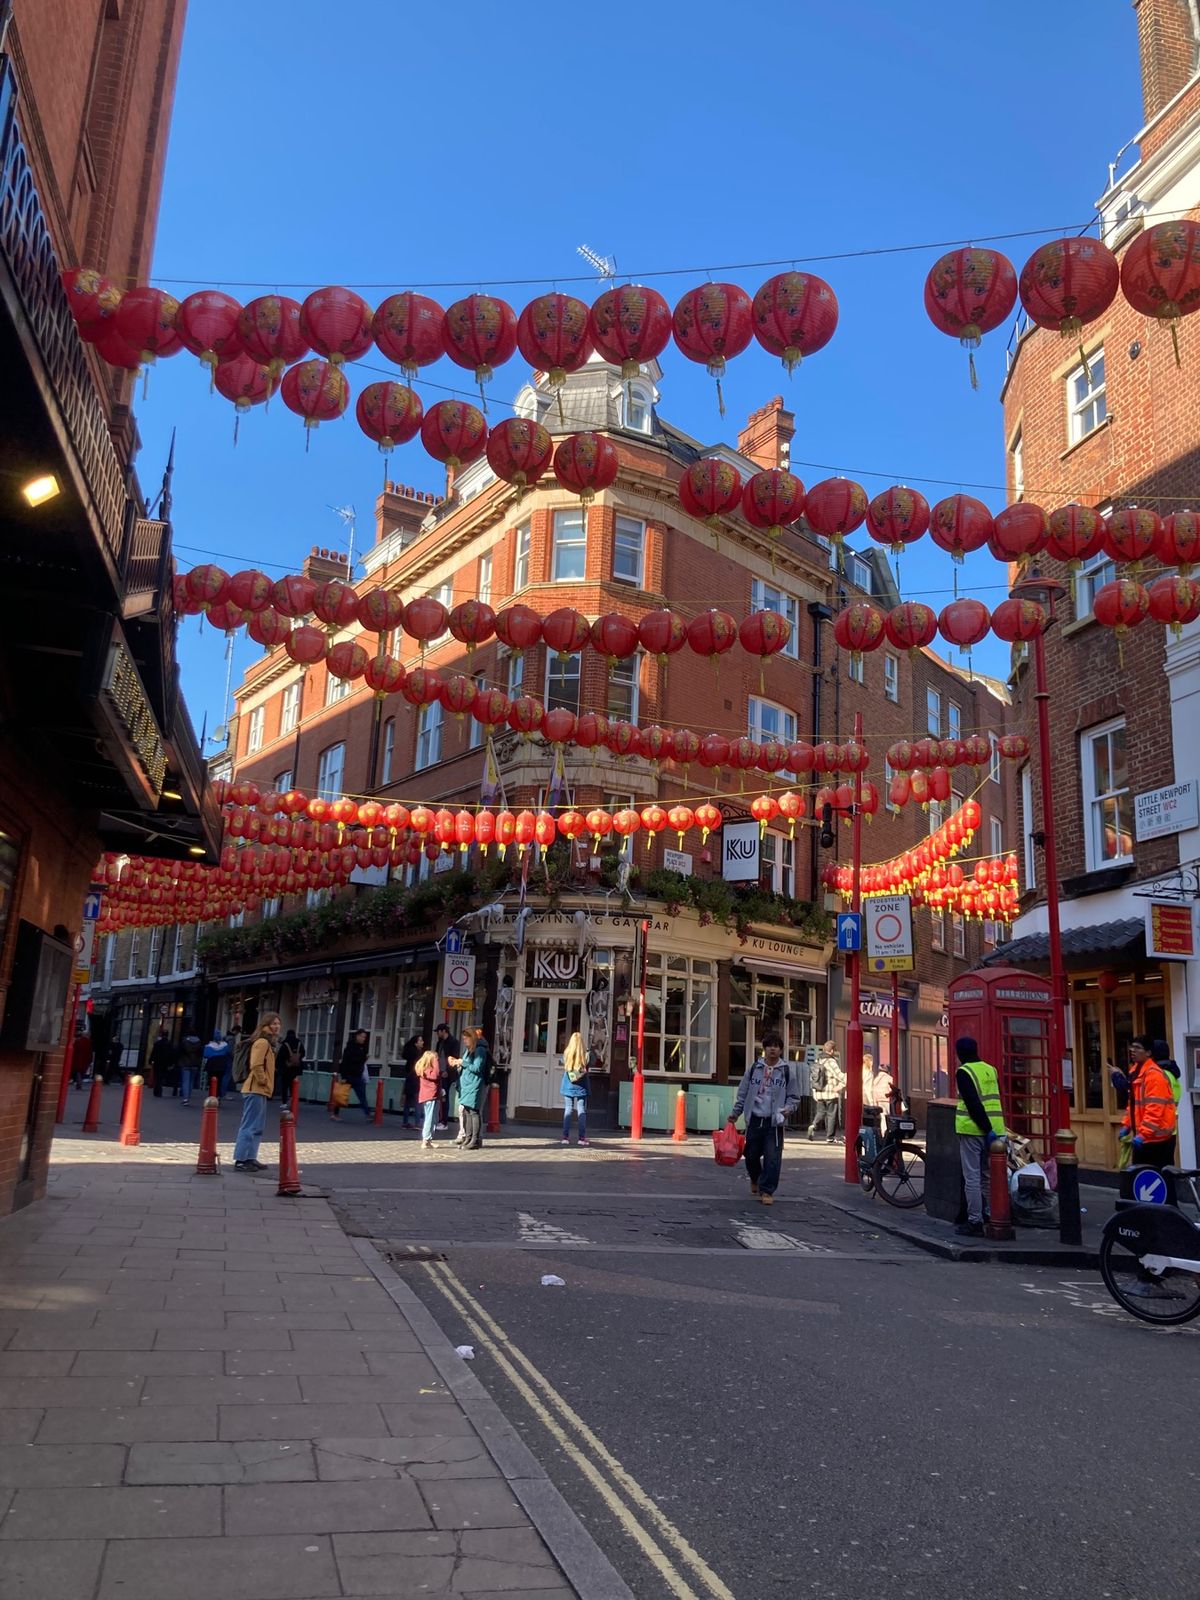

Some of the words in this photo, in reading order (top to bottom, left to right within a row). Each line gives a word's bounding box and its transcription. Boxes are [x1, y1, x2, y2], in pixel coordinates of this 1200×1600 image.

[1138, 793, 1159, 808] LITTLE
[1160, 783, 1191, 802] NEWPORT
[1138, 803, 1161, 818] STREET
[1162, 799, 1177, 812] WC2
[726, 838, 756, 861] KU
[869, 896, 905, 905] PEDESTRIAN
[874, 903, 900, 913] ZONE
[612, 916, 640, 928] GAY
[646, 920, 670, 931] BAR
[752, 938, 765, 949] KU
[768, 942, 804, 957] LOUNGE
[533, 949, 580, 980] KU
[996, 990, 1049, 1001] TELEPHONE
